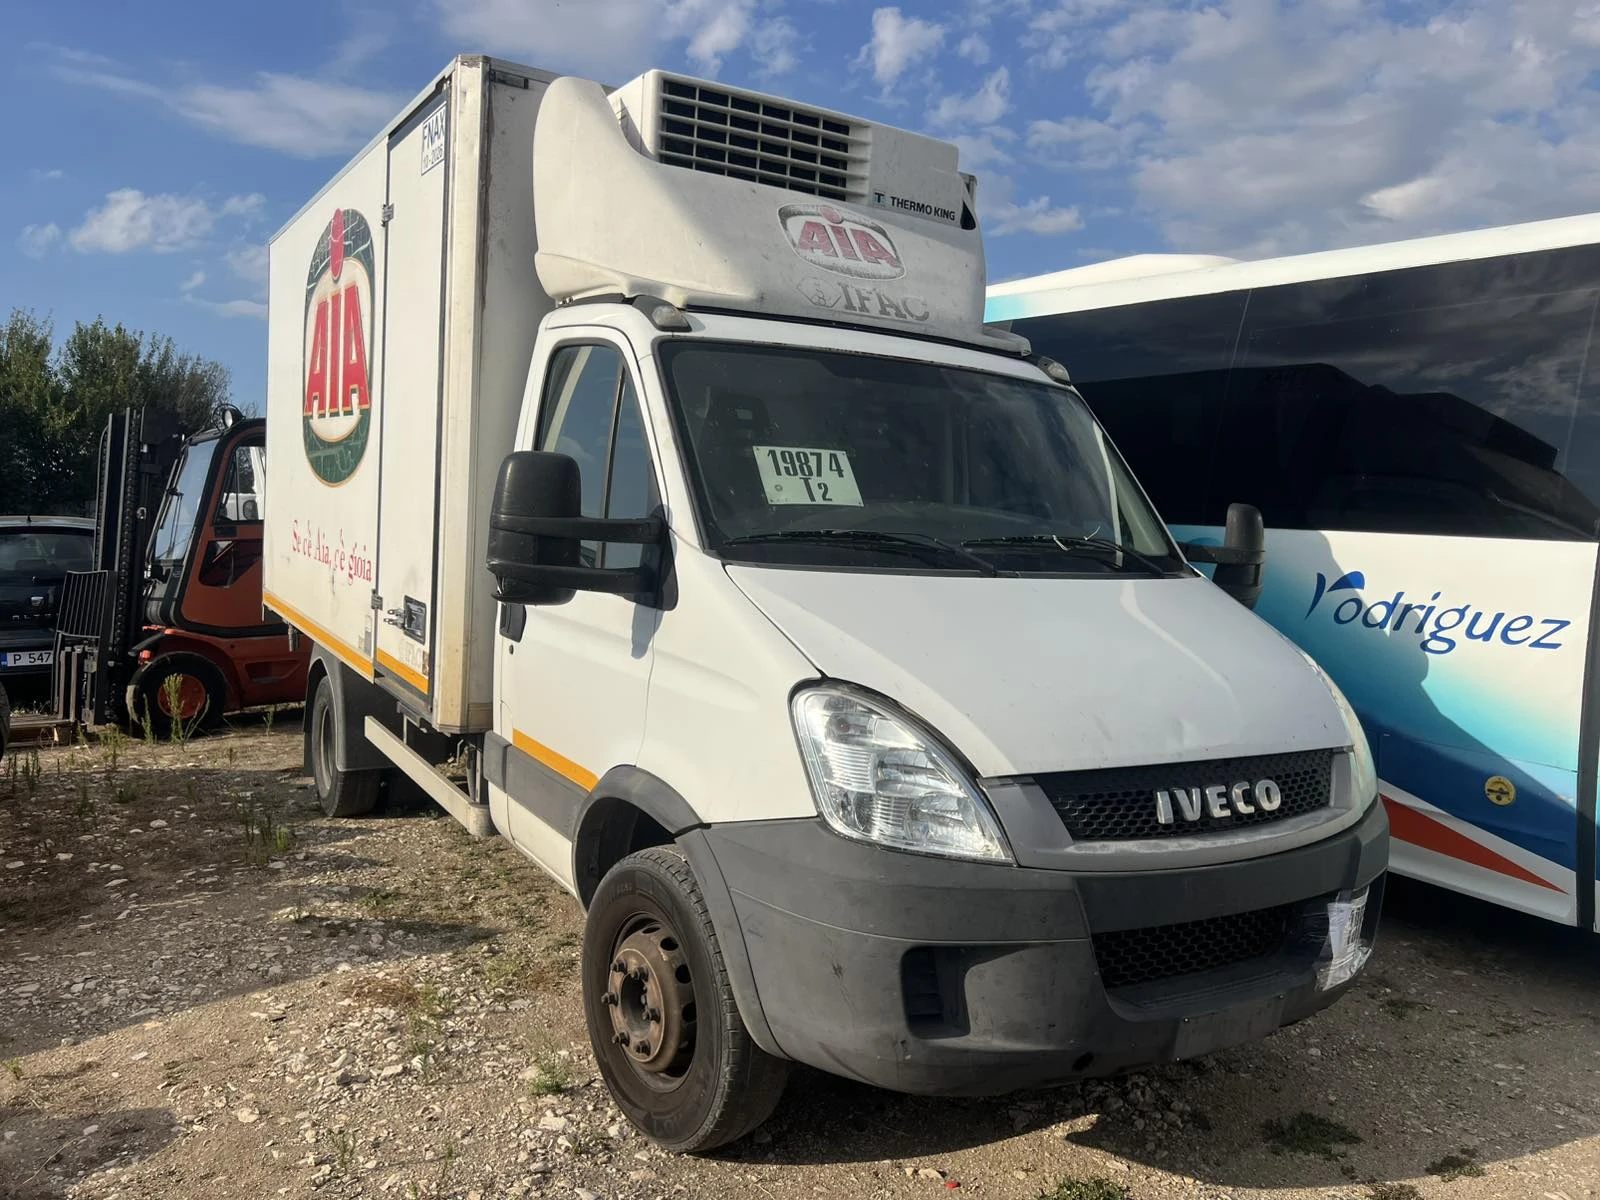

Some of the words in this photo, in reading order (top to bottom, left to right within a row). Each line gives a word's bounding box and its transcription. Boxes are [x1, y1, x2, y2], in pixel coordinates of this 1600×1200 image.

[890, 196, 933, 215] THERMO
[933, 207, 956, 222] KING
[767, 449, 844, 478] 19874
[348, 542, 372, 586] gioia
[13, 654, 22, 665] P
[1156, 779, 1282, 825] IVECO
